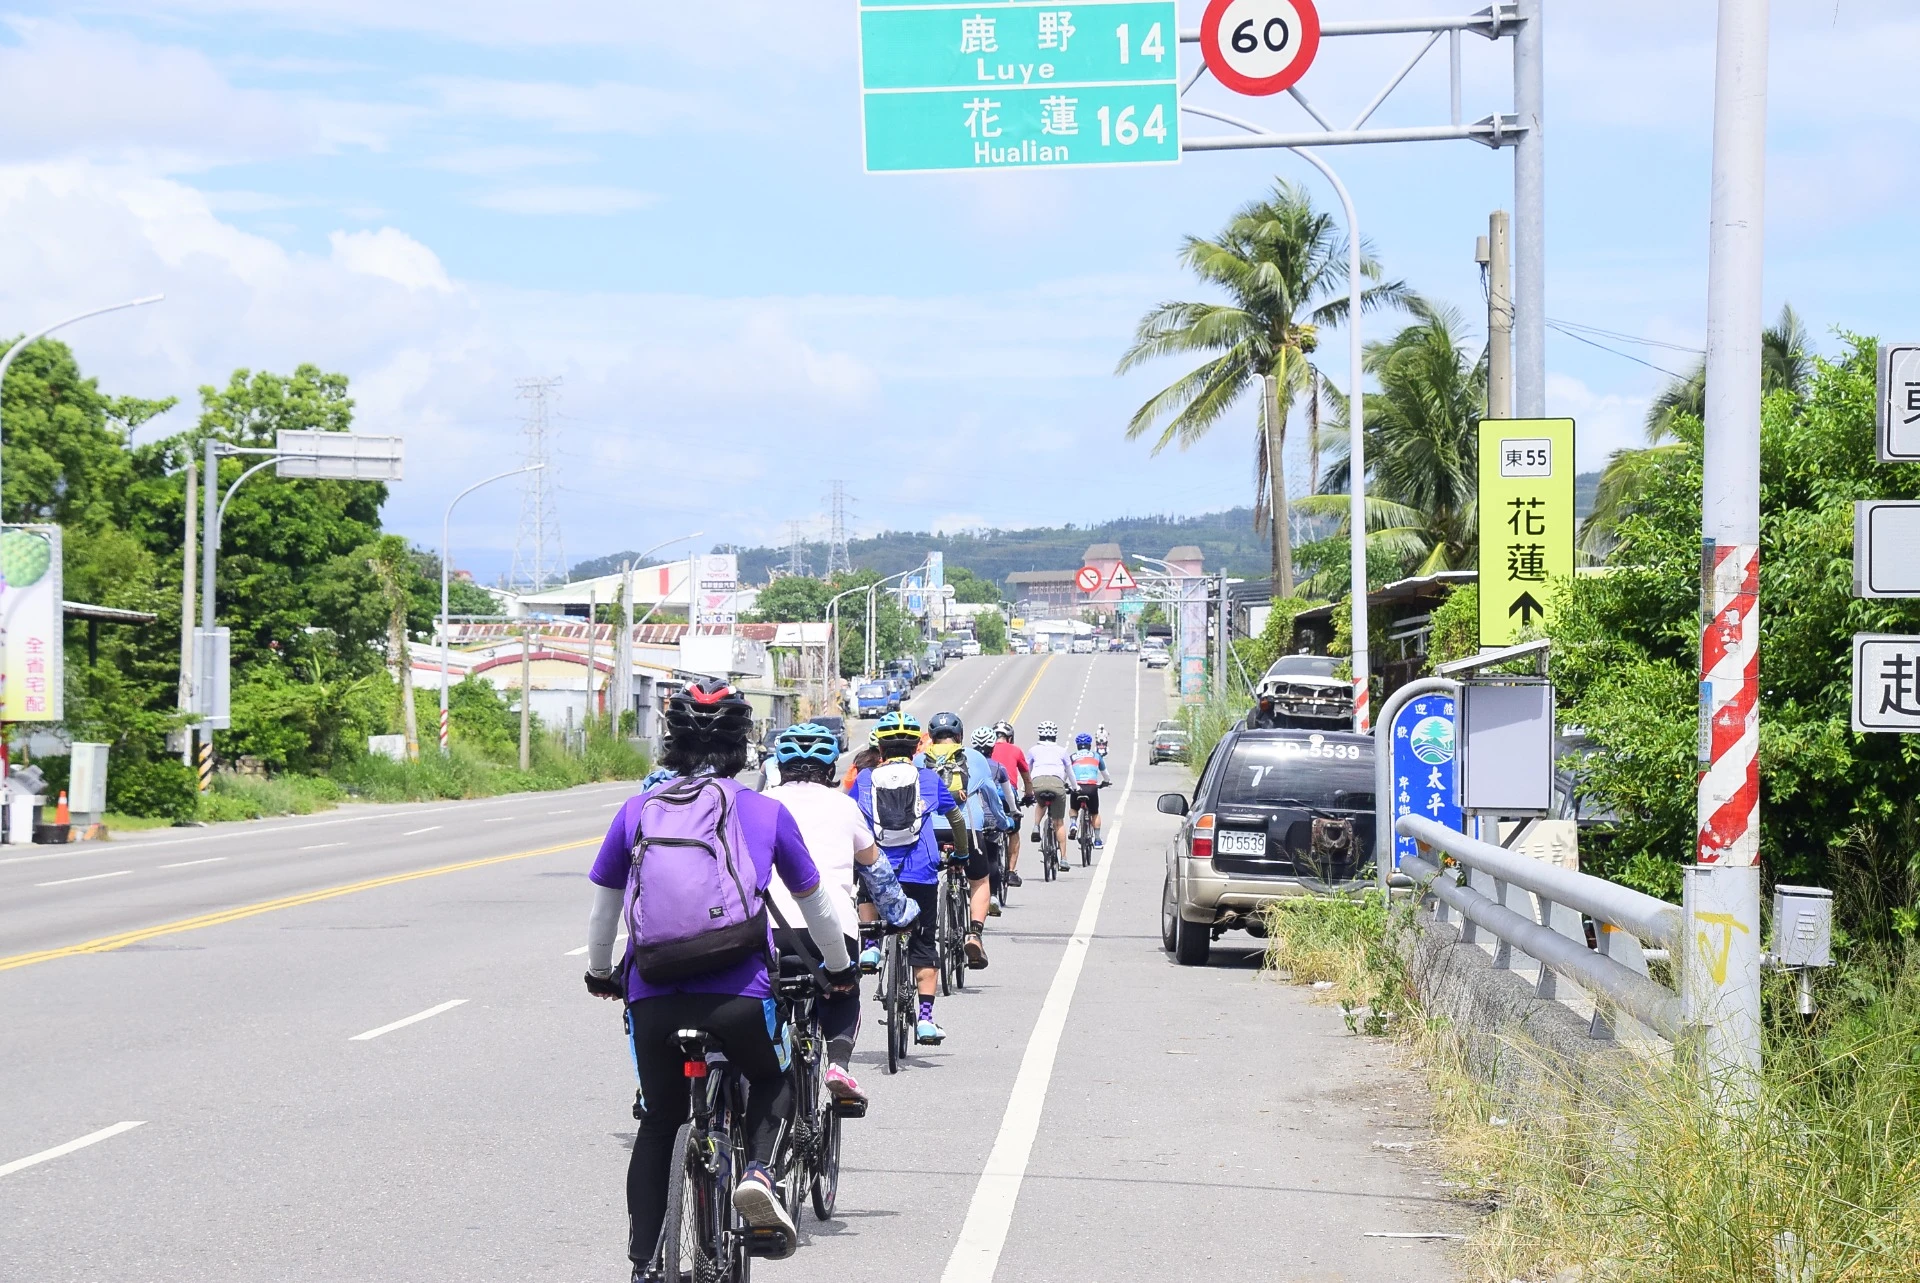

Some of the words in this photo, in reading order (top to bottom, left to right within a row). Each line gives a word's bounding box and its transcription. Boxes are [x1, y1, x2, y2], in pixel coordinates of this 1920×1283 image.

[960, 12, 1077, 55] 鹿野
[1115, 22, 1166, 65] 14
[1231, 17, 1289, 54] 60
[976, 58, 1056, 84] Luye
[963, 95, 1079, 139] 花蓮
[1097, 104, 1168, 147] 164
[973, 140, 1069, 165] Hualian
[1507, 497, 1546, 582] 花蓮
[25, 637, 46, 713] 全省宅配
[1426, 766, 1447, 828] 太平
